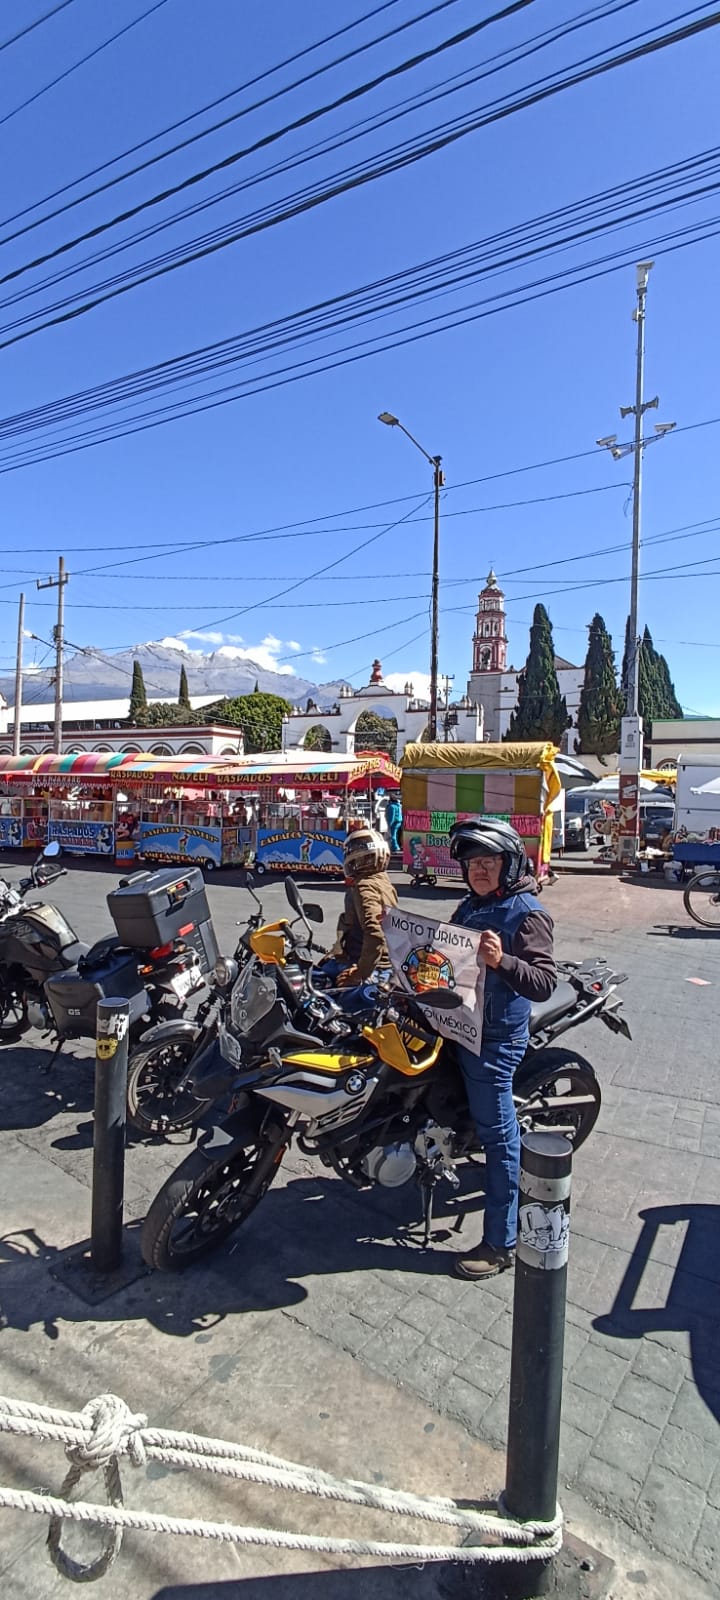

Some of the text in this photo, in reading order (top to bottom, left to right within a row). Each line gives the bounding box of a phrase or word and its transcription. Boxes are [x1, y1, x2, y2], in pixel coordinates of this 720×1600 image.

[110, 770, 208, 782] RASPADOS NAYELI
[216, 773, 339, 783] RASPADOS NAYELI
[391, 916, 474, 950] MOTO TURISTA
[439, 1014, 478, 1038] MÉXICO
